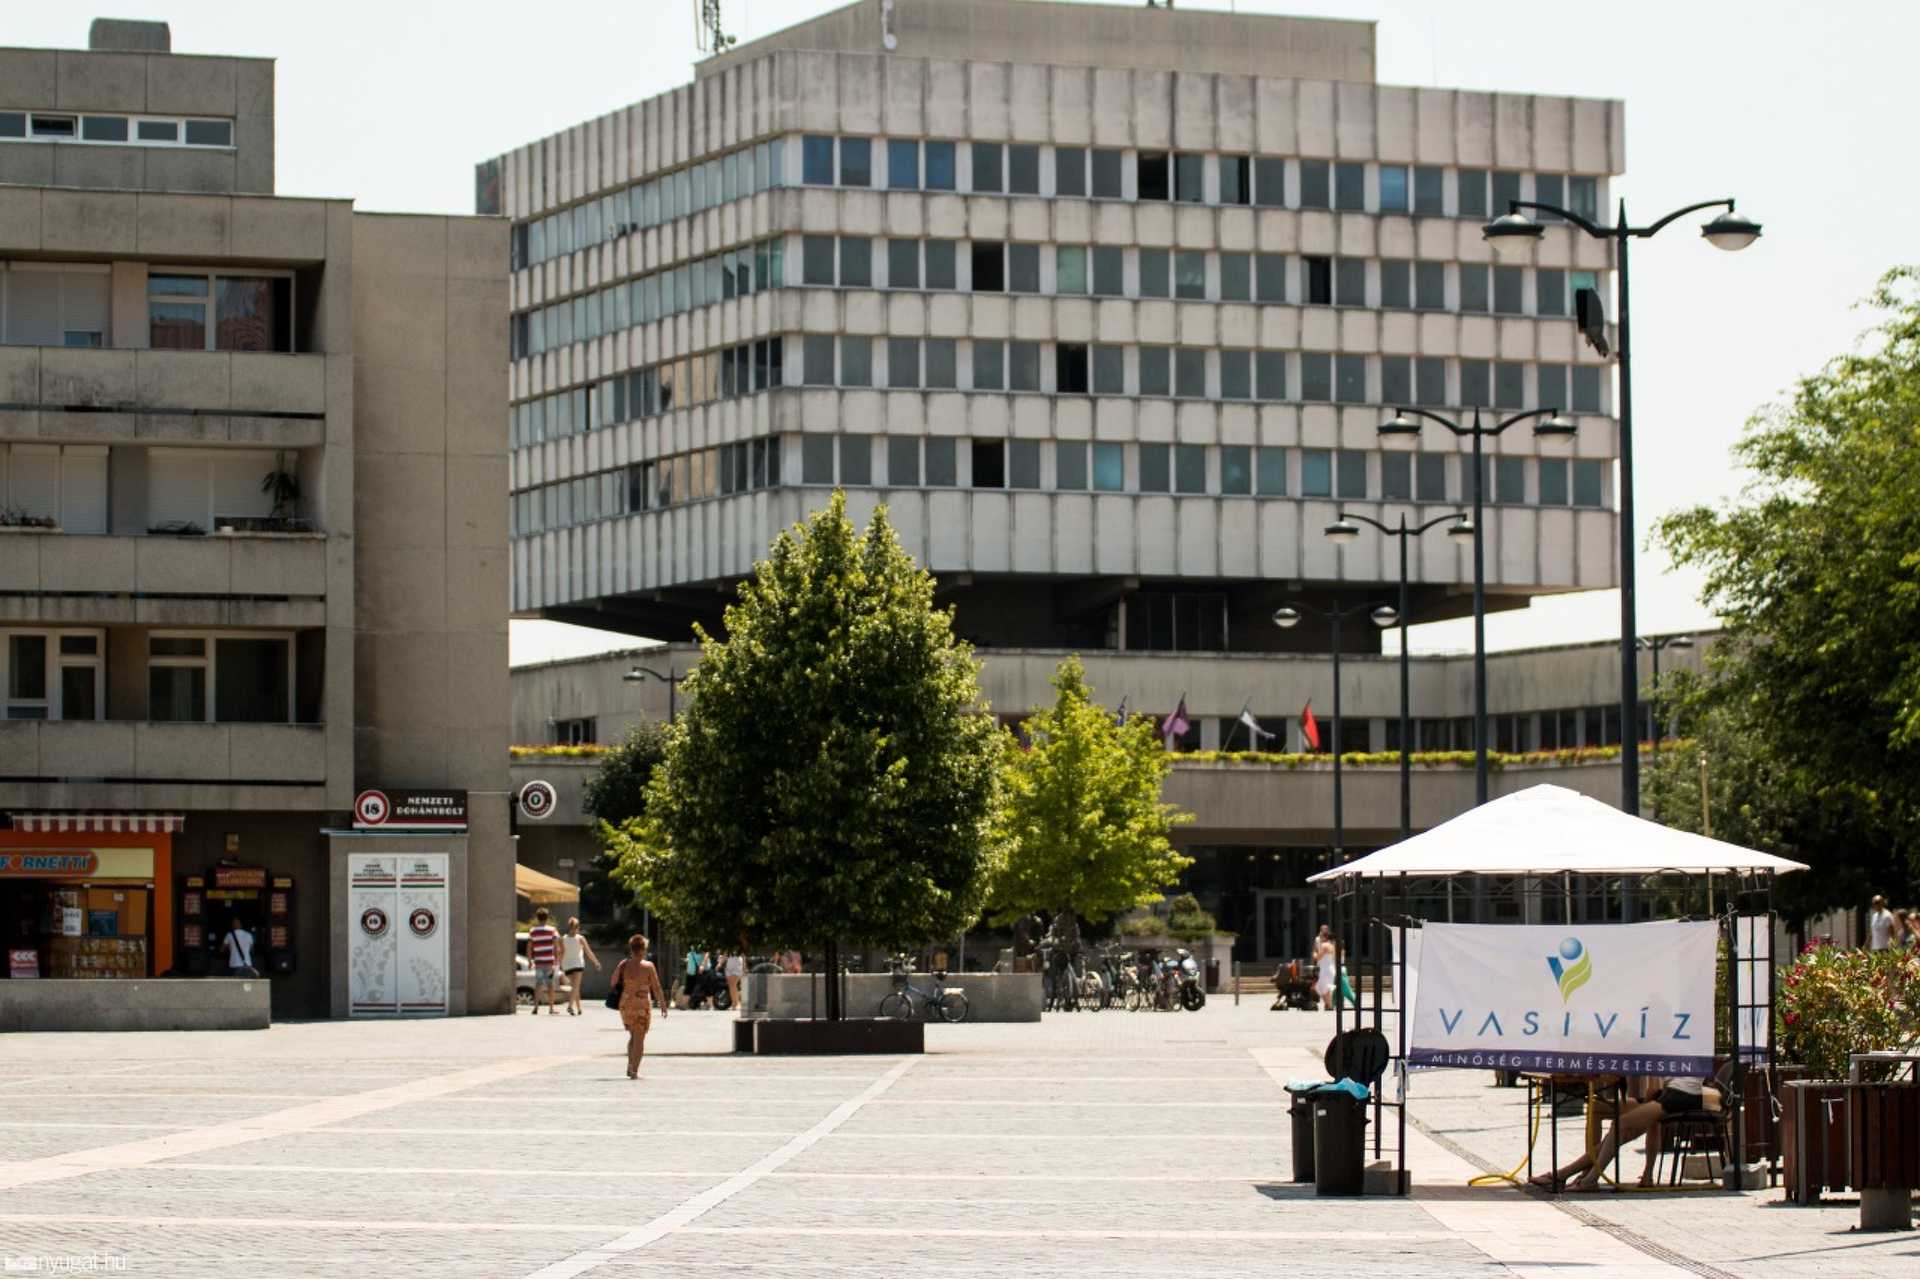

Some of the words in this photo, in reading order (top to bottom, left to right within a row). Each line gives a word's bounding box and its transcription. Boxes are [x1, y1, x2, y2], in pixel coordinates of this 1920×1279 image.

[407, 797, 454, 805] NEMZETI
[364, 803, 380, 815] 18
[1439, 1006, 1691, 1040] VASIVÍZ
[1534, 1055, 1692, 1073] TERMÉSZETESEN
